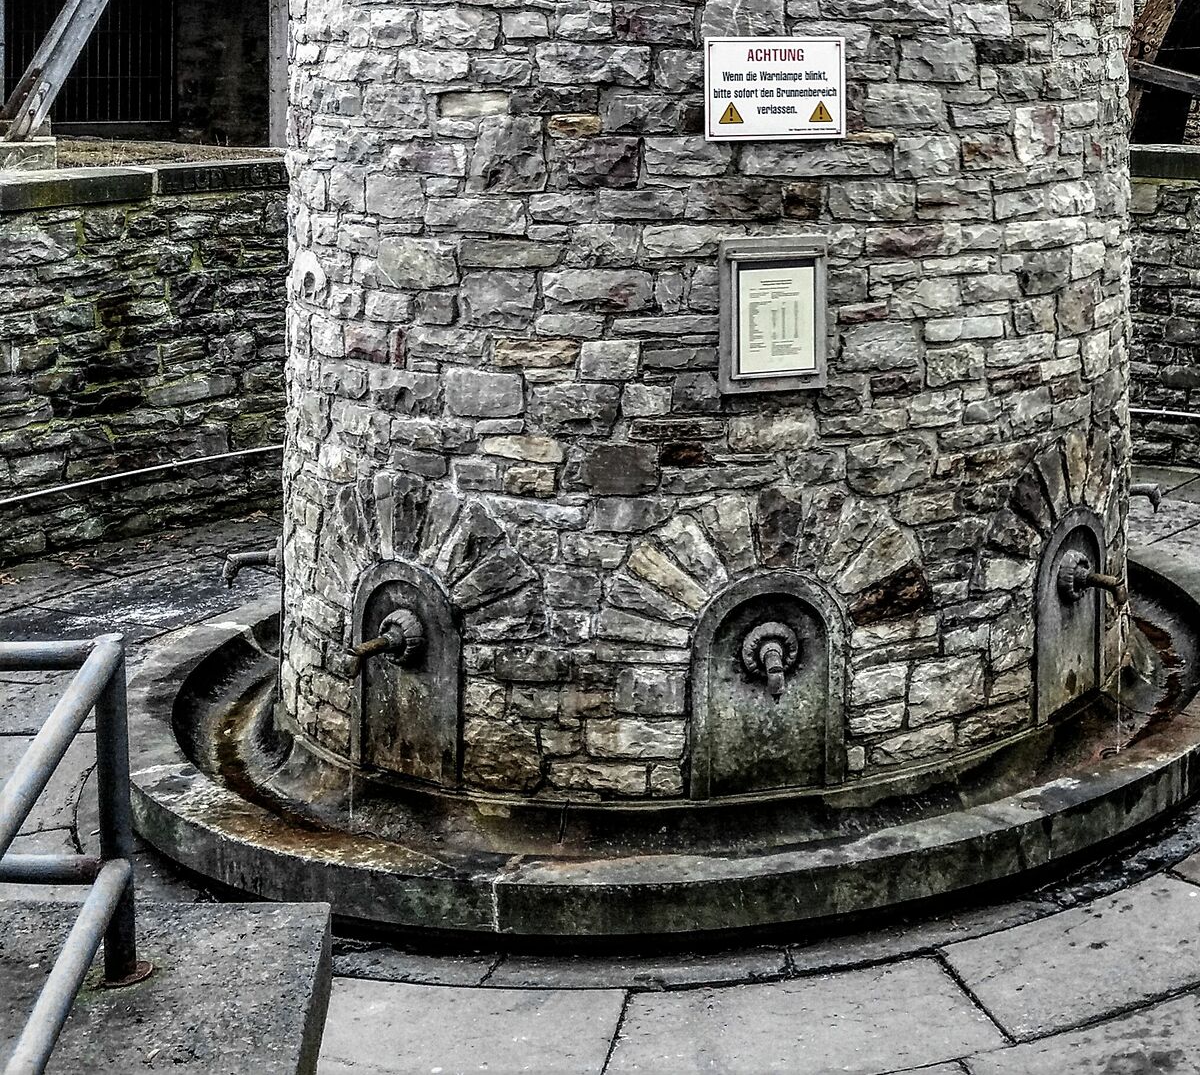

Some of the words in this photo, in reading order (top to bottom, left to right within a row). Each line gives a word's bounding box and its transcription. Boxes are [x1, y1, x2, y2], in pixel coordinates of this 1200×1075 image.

[747, 48, 804, 61] ACHTUNG
[722, 71, 744, 82] Wenn
[746, 71, 758, 82] die
[759, 71, 803, 82] Warnlampe
[805, 71, 828, 82] blinkt,
[713, 88, 732, 99] bitte
[734, 88, 758, 99] sofort
[760, 88, 775, 98] den
[776, 87, 837, 98] Brunnenbereich
[757, 104, 798, 115] verlassen.
